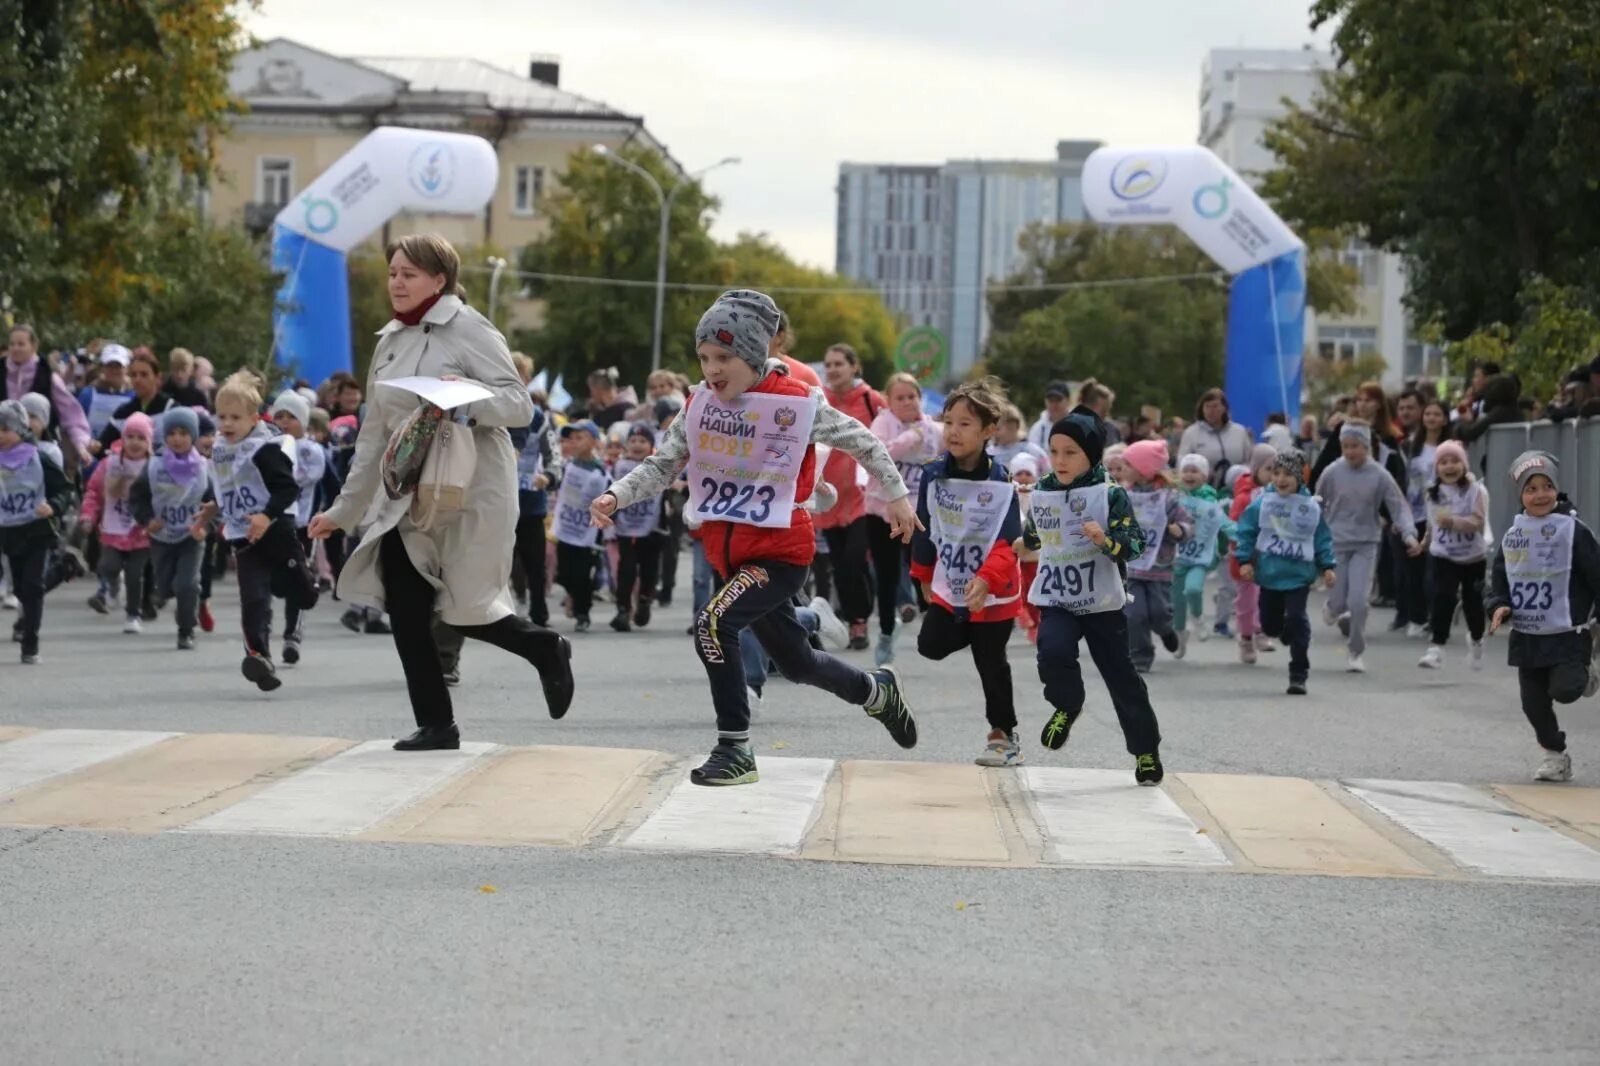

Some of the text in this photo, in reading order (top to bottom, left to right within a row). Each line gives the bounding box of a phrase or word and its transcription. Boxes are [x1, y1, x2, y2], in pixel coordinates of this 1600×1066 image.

[704, 403, 745, 421] КРОСС
[699, 416, 756, 438] НАЦИИ
[222, 486, 257, 515] 748
[697, 477, 775, 522] 2823
[1040, 561, 1096, 597] 2497
